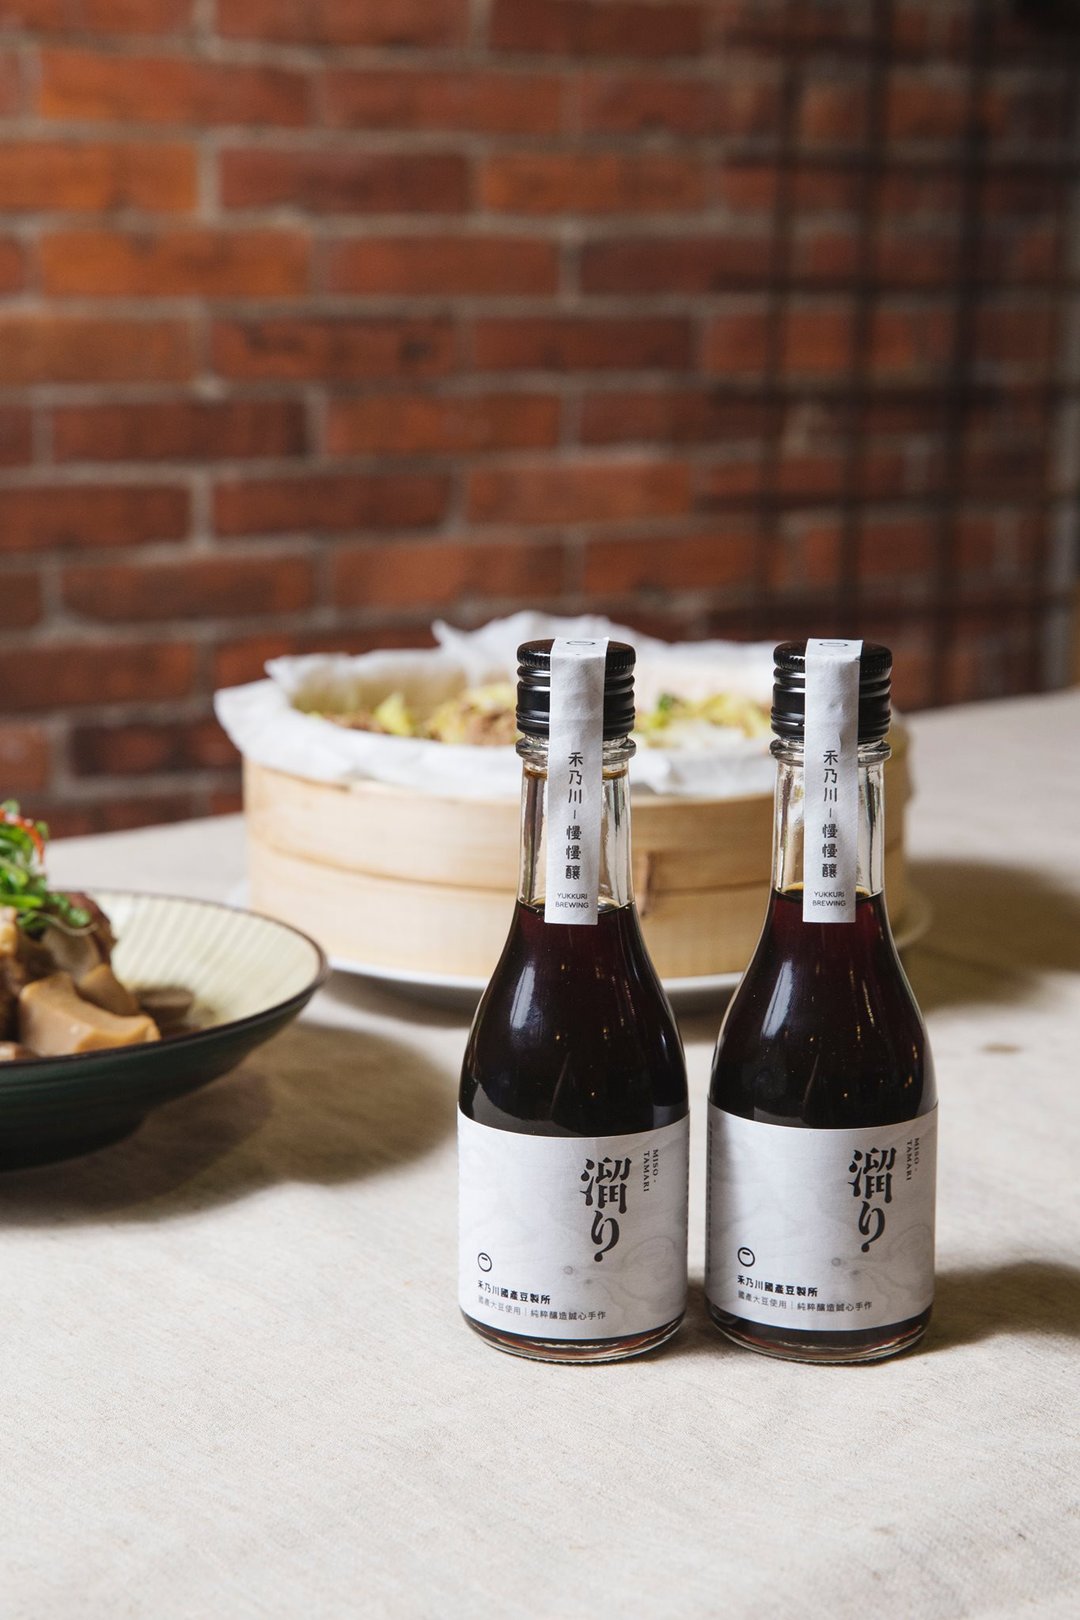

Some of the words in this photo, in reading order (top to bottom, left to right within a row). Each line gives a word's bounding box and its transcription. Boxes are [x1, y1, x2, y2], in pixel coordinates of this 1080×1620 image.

[557, 892, 588, 900] YUKKURI
[814, 890, 845, 898] YUKKURI
[555, 901, 589, 909] BREWING
[812, 899, 846, 907] BREWING
[847, 1147, 897, 1253] 溜り
[580, 1156, 632, 1262] 溜り
[477, 1279, 551, 1305] 禾乃川國產豆製所
[737, 1274, 818, 1298] 禾乃川國產豆製所
